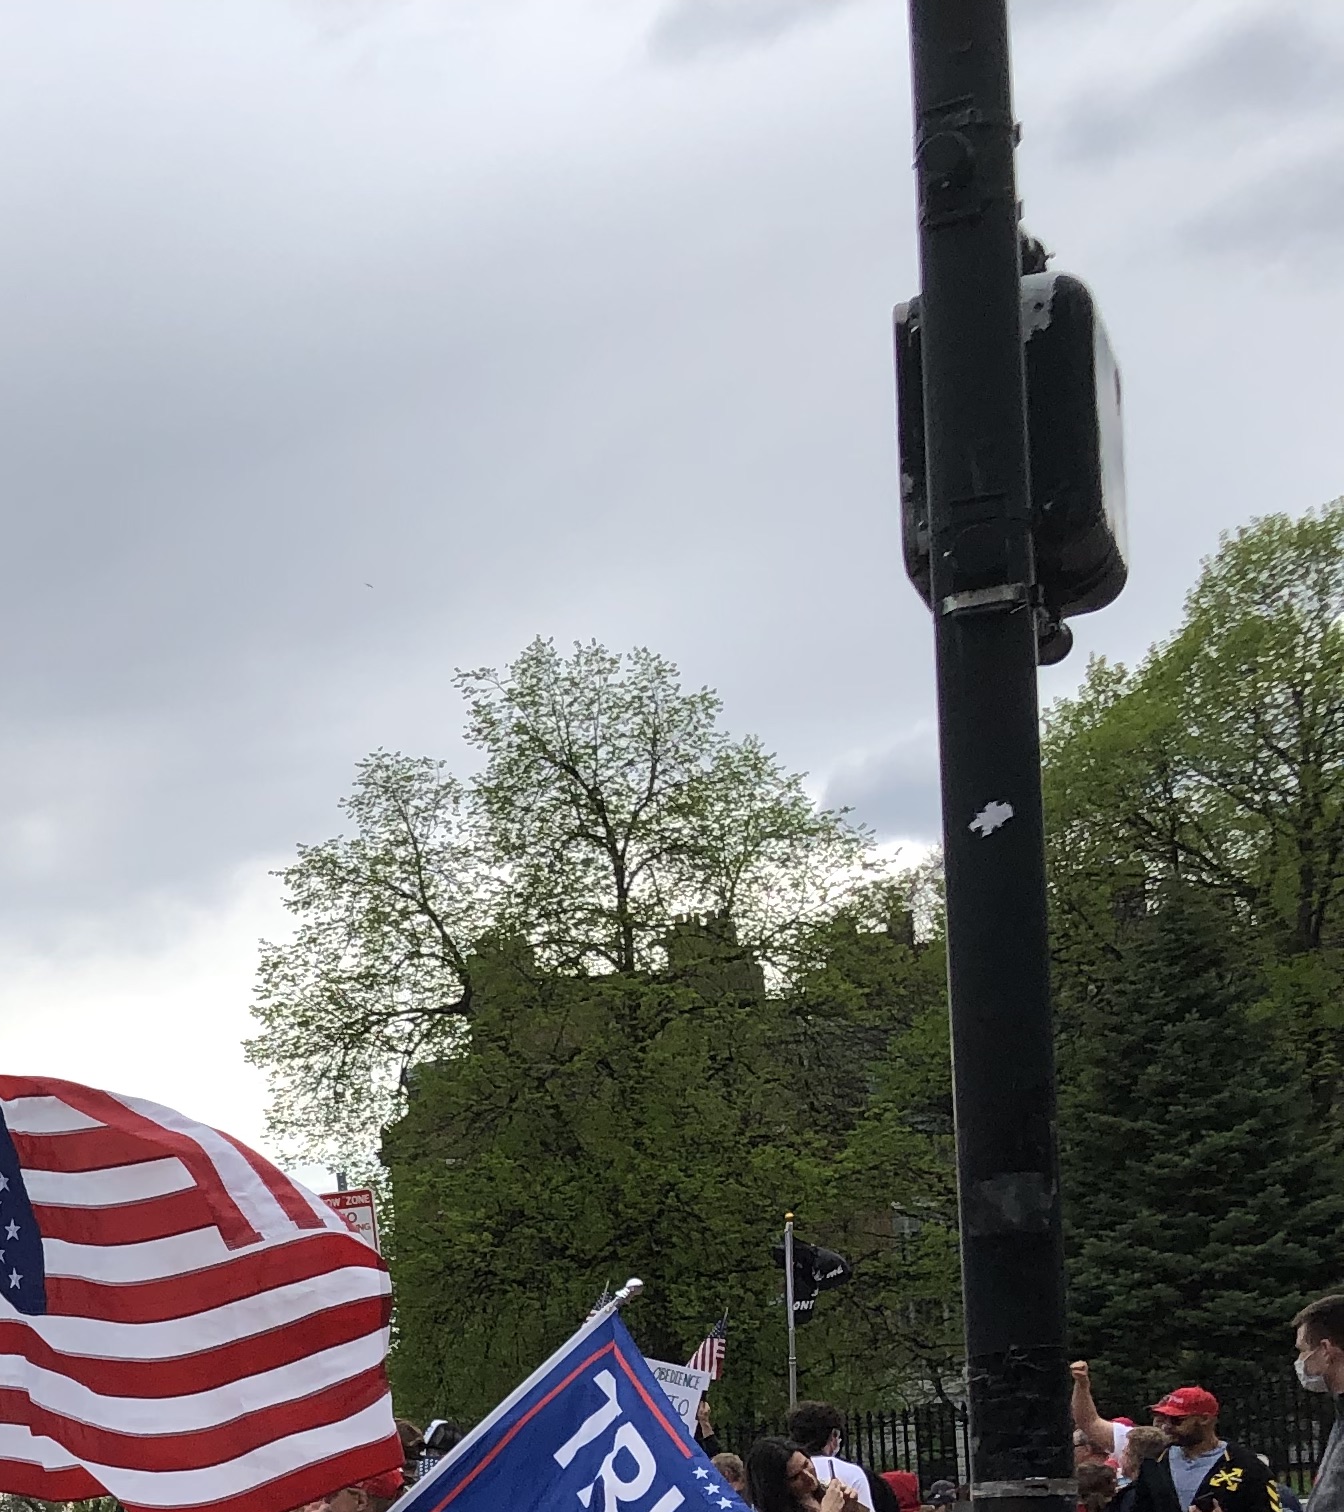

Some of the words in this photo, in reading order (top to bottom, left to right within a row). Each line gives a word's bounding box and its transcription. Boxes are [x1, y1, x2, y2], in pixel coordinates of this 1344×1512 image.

[323, 1198, 341, 1207] OW
[345, 1193, 371, 1206] ZONE
[653, 1366, 702, 1391] OBEDIENCE
[667, 1394, 690, 1416] TO
